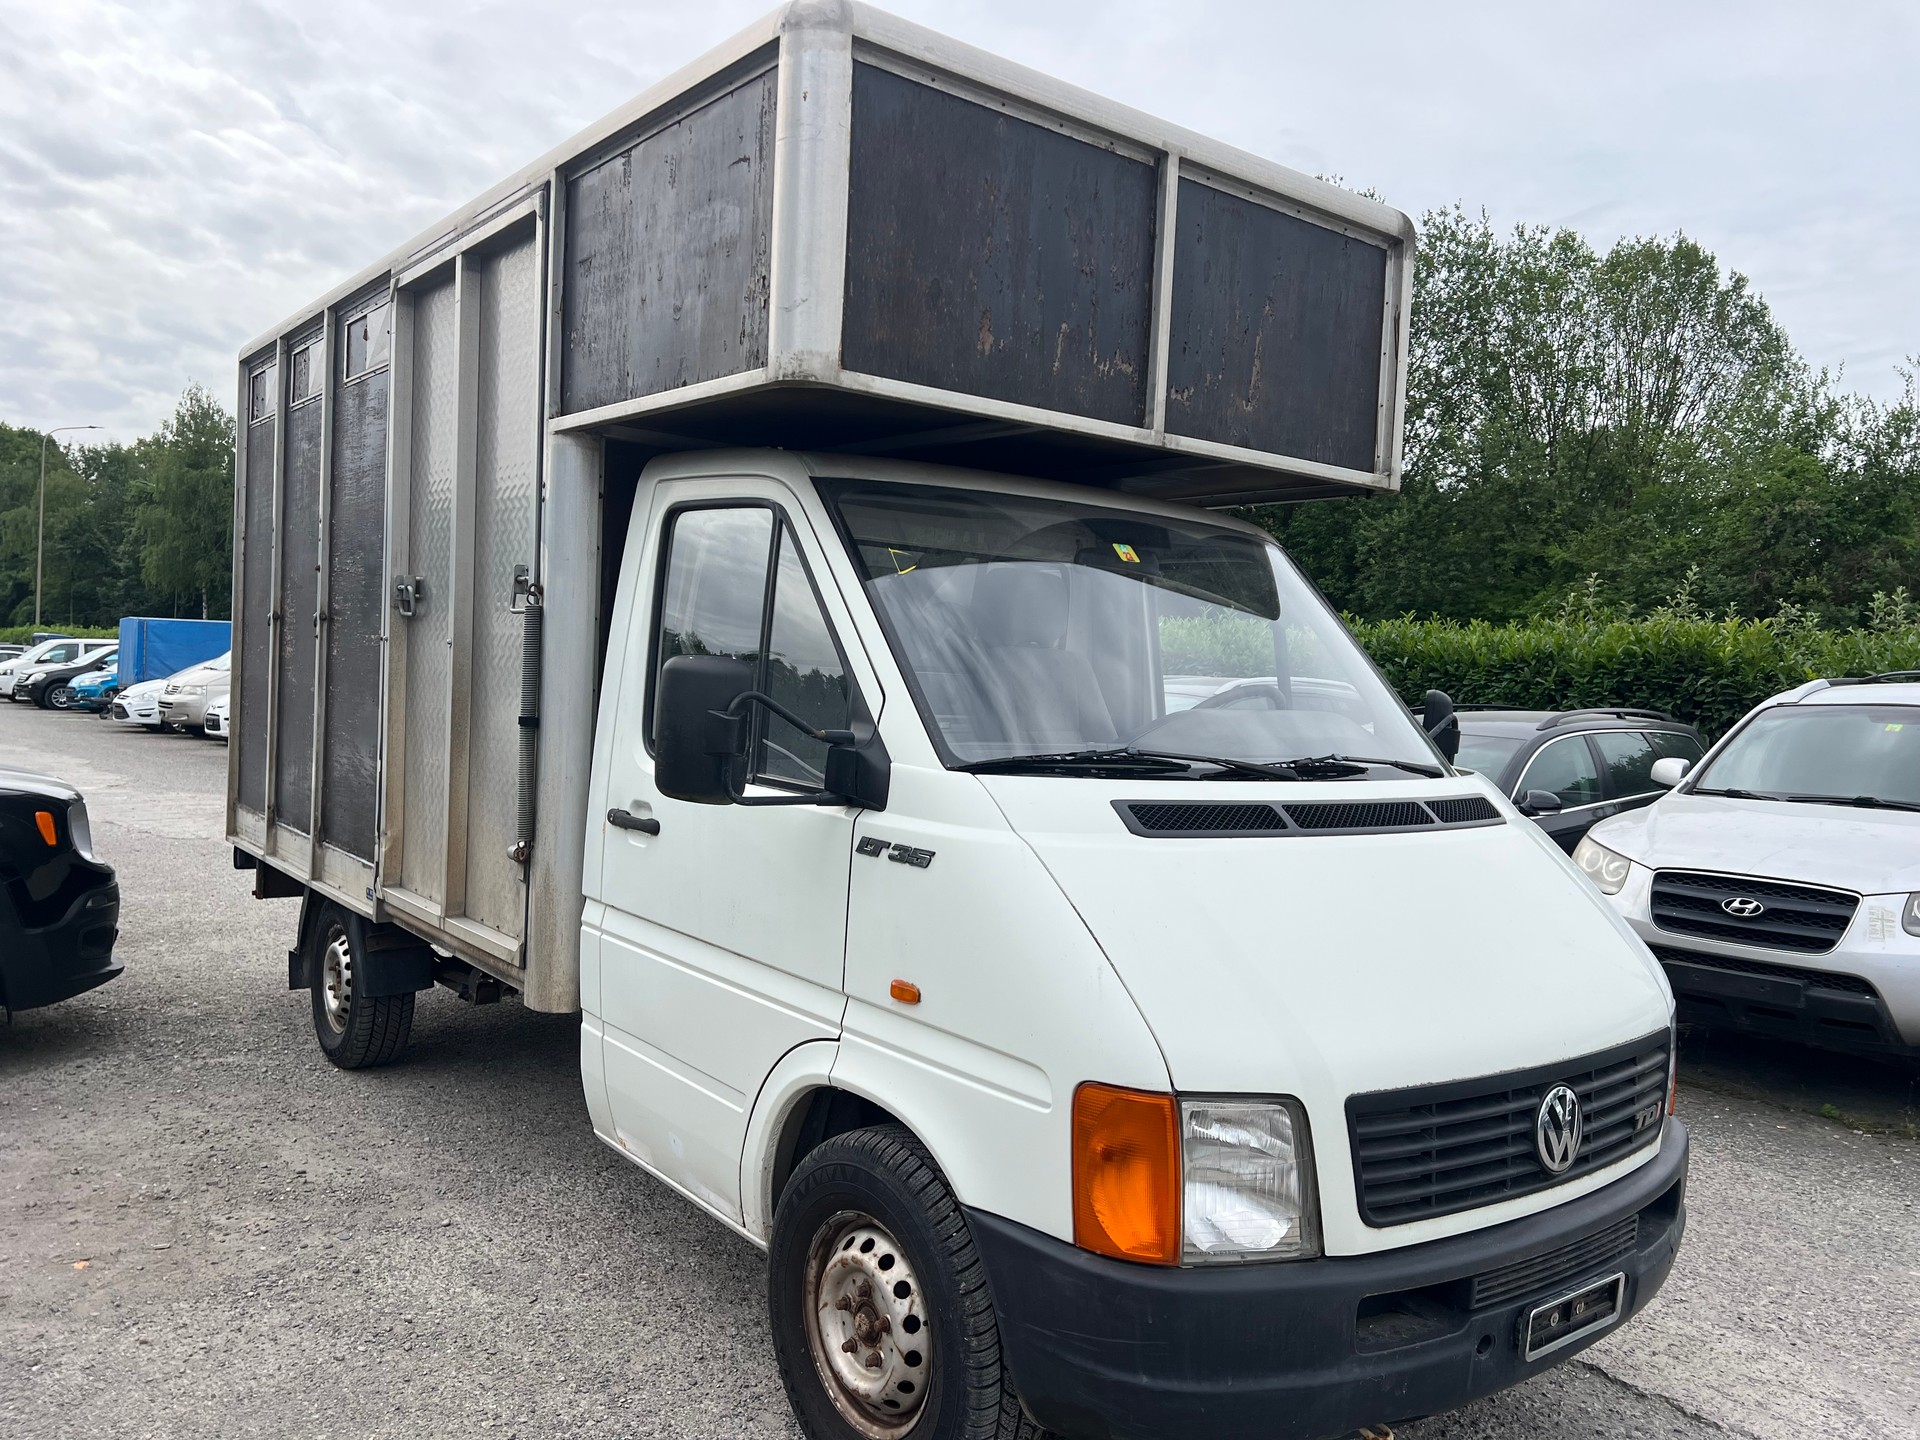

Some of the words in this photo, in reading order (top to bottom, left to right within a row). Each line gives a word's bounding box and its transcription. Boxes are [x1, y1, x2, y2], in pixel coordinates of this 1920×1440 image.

[855, 836, 892, 858] LT
[888, 843, 936, 869] 35
[1635, 1100, 1662, 1130] TDI
